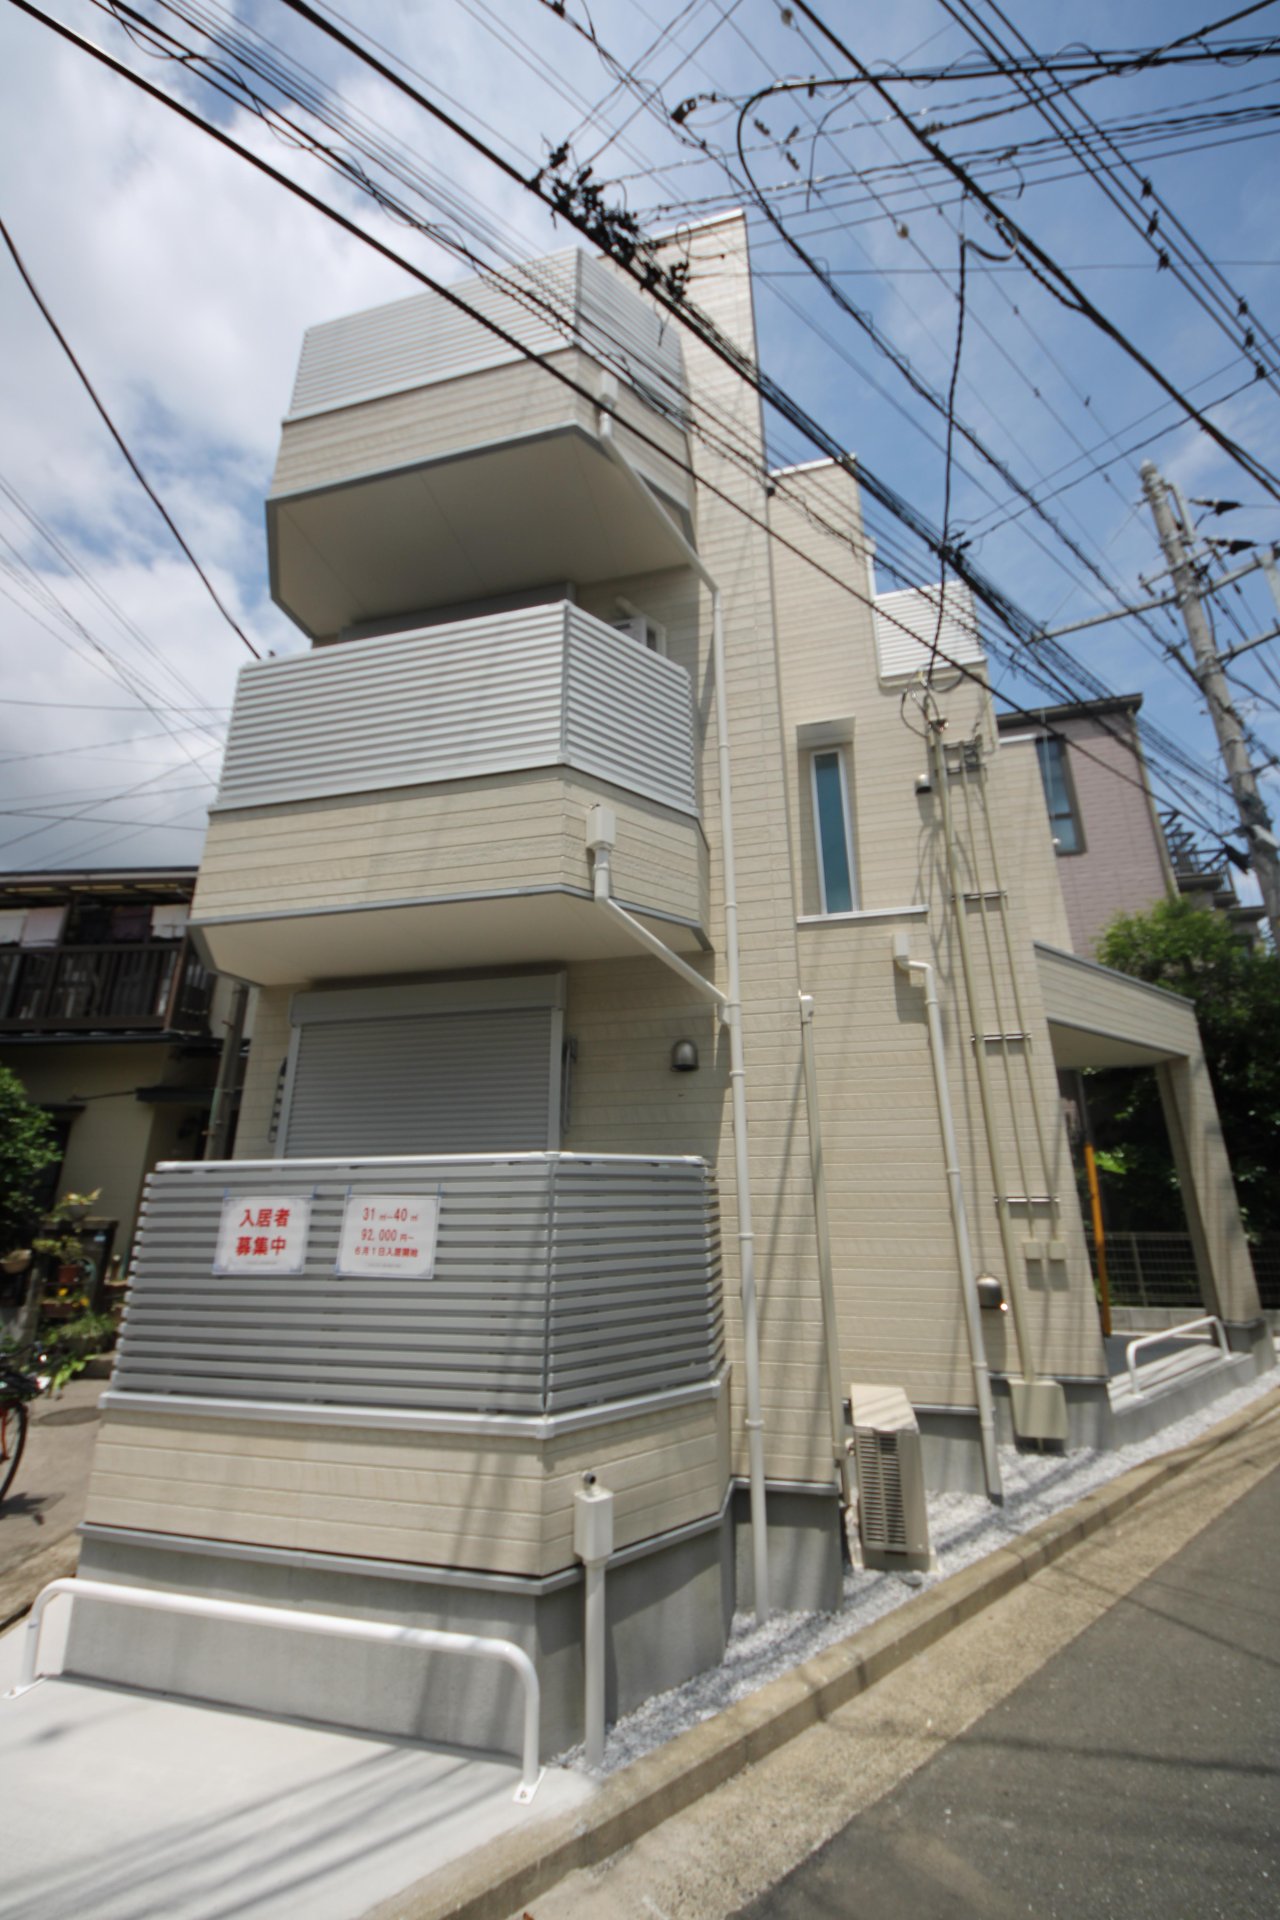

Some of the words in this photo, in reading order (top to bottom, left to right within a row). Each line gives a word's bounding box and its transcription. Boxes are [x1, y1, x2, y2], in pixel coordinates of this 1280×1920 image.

[239, 1208, 290, 1228] 入居者
[236, 1236, 286, 1256] 募集中
